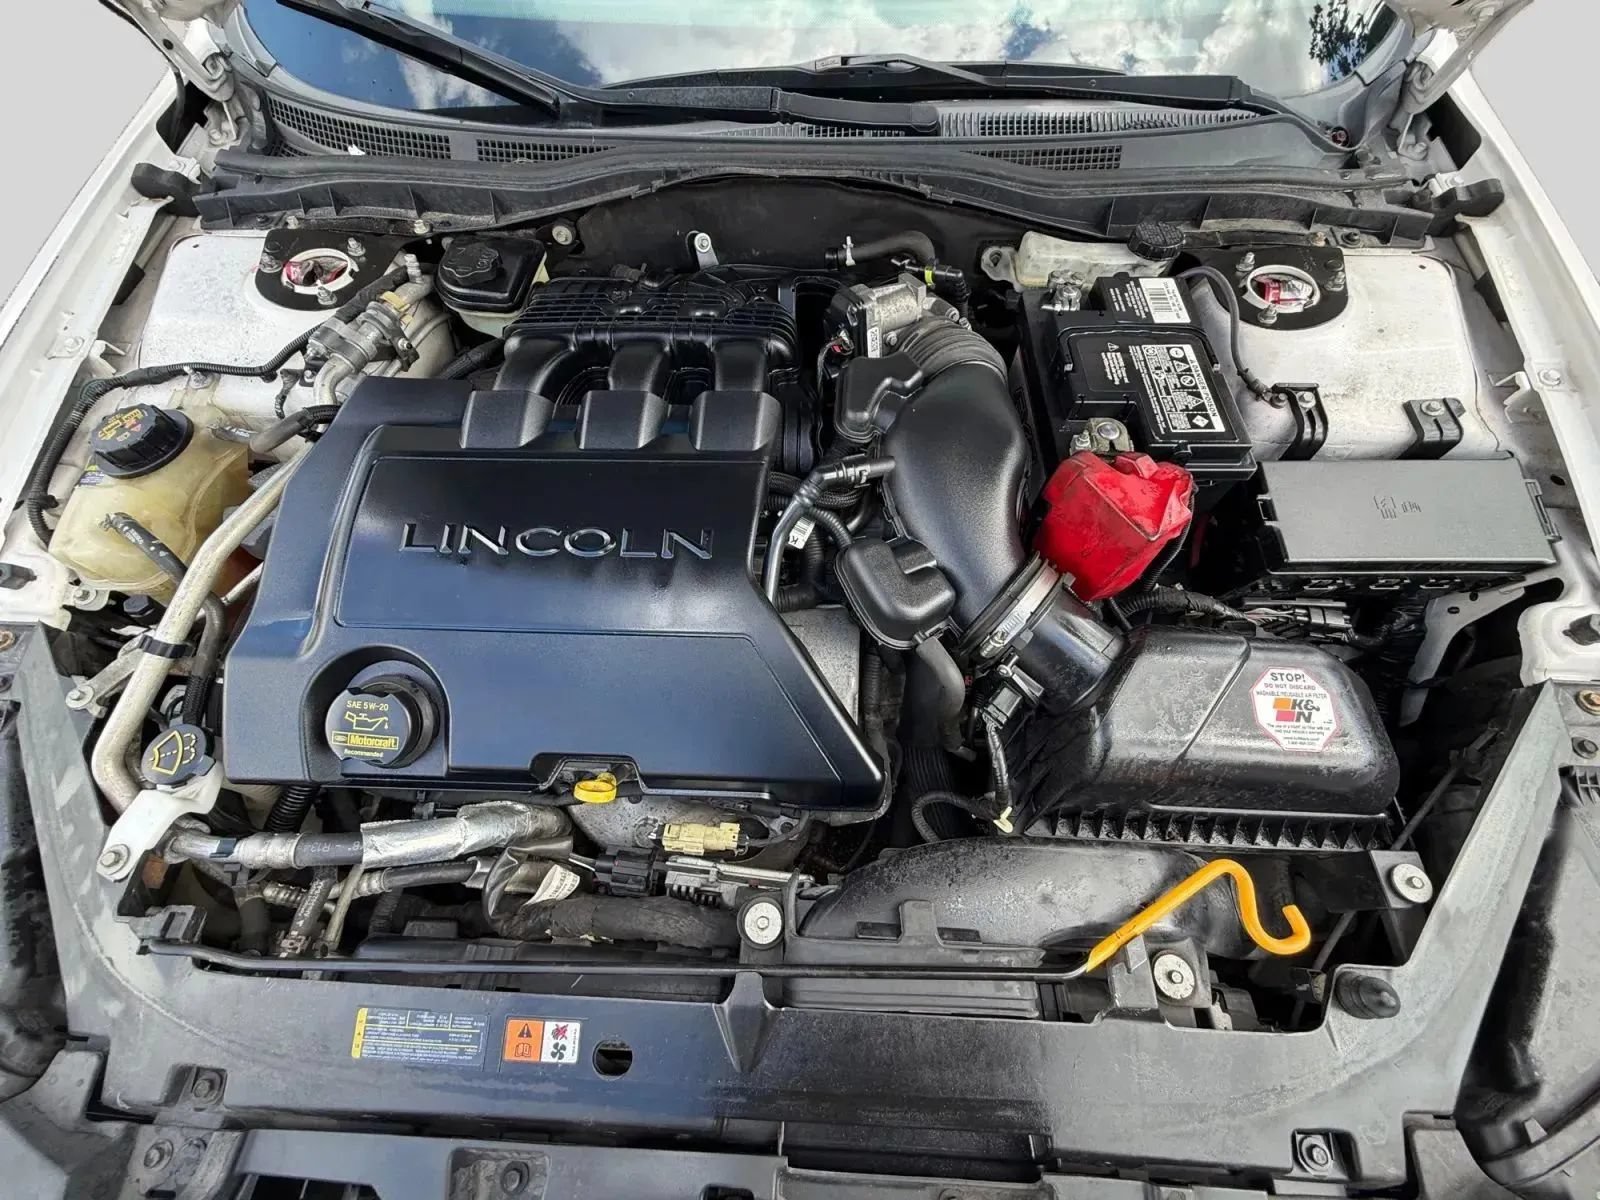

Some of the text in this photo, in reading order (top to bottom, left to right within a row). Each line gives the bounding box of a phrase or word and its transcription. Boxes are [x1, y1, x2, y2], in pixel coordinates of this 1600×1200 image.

[398, 523, 713, 560] LINCOLN
[1270, 672, 1306, 683] STOP!
[346, 700, 389, 711] SAE 5W-20
[350, 735, 396, 748] Motorcraft
[344, 748, 384, 758] Recommended
